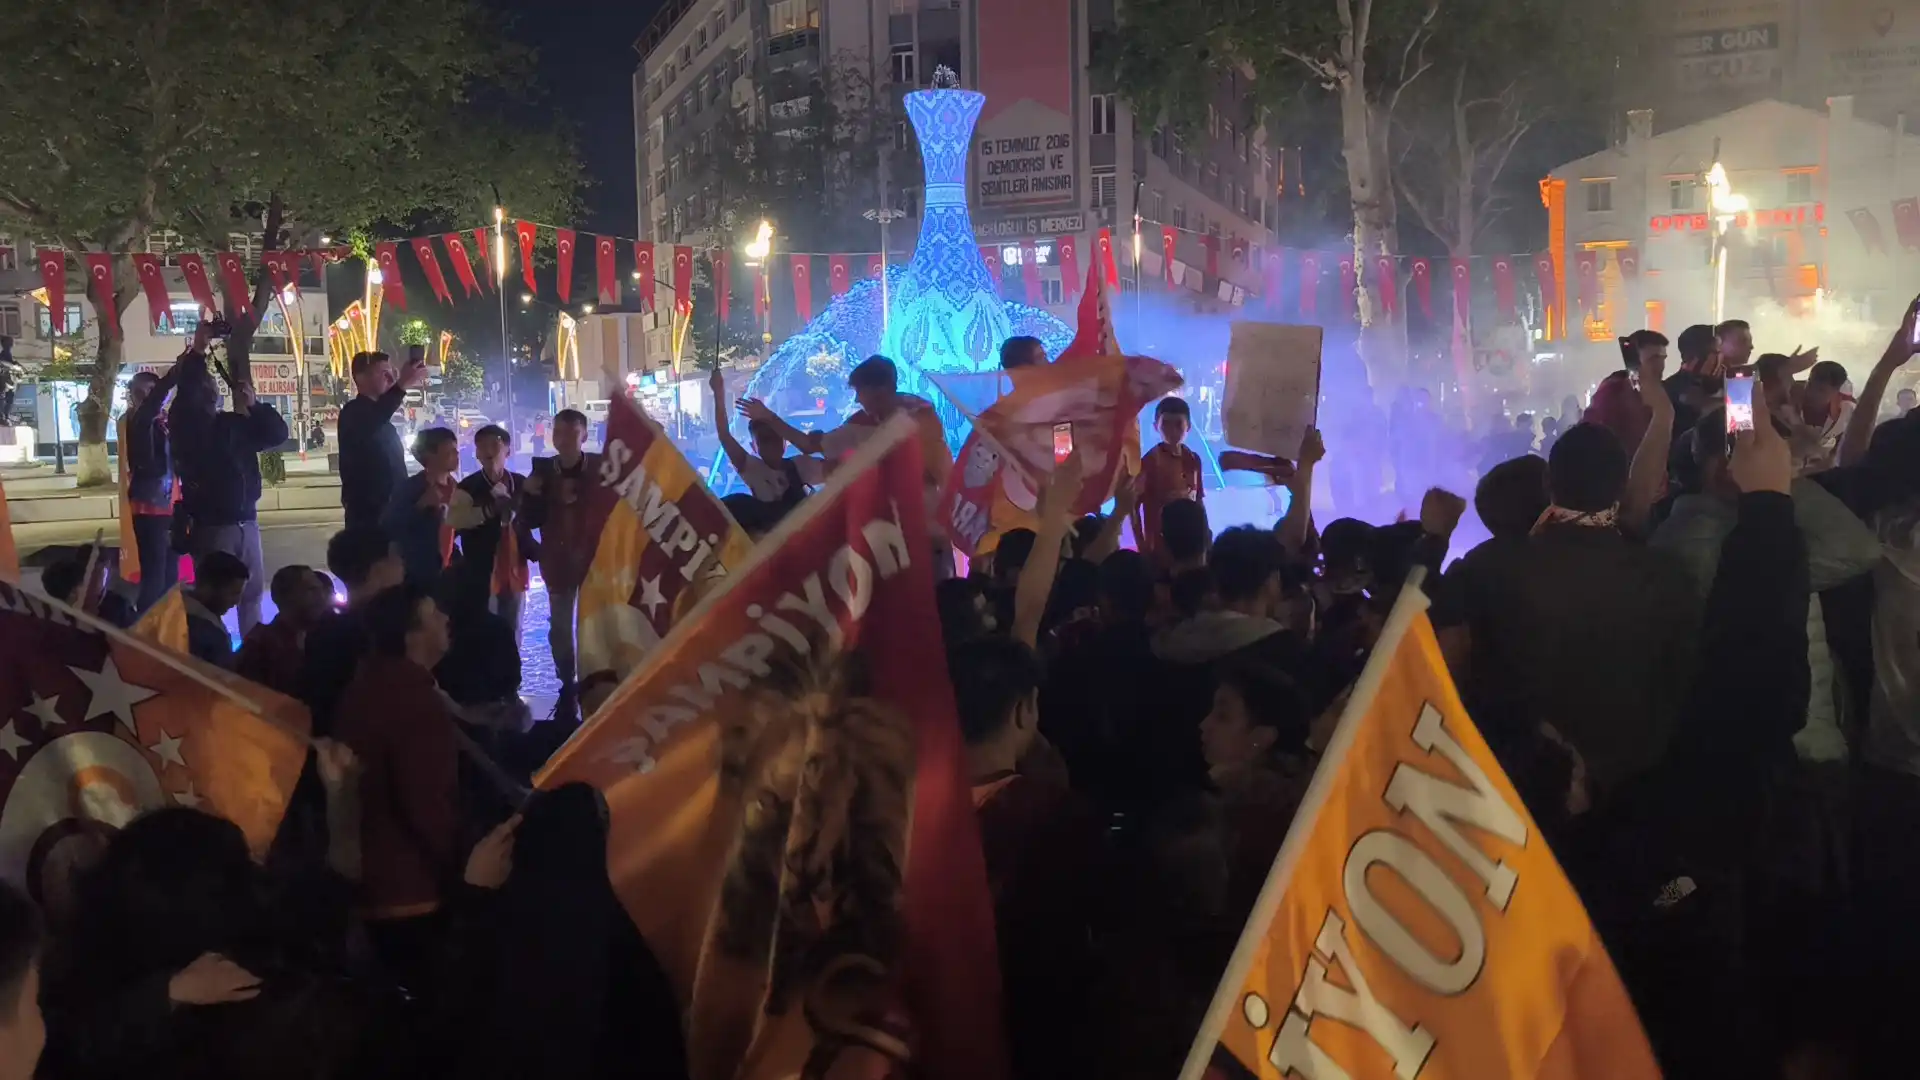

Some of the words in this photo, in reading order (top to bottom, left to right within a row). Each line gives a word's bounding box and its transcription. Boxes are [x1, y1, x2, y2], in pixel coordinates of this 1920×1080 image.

[981, 141, 993, 156] 15
[995, 136, 1041, 154] TEMMUZ
[1046, 133, 1070, 150] 2016
[1050, 154, 1064, 170] VE
[1031, 175, 1072, 192] ANISINA
